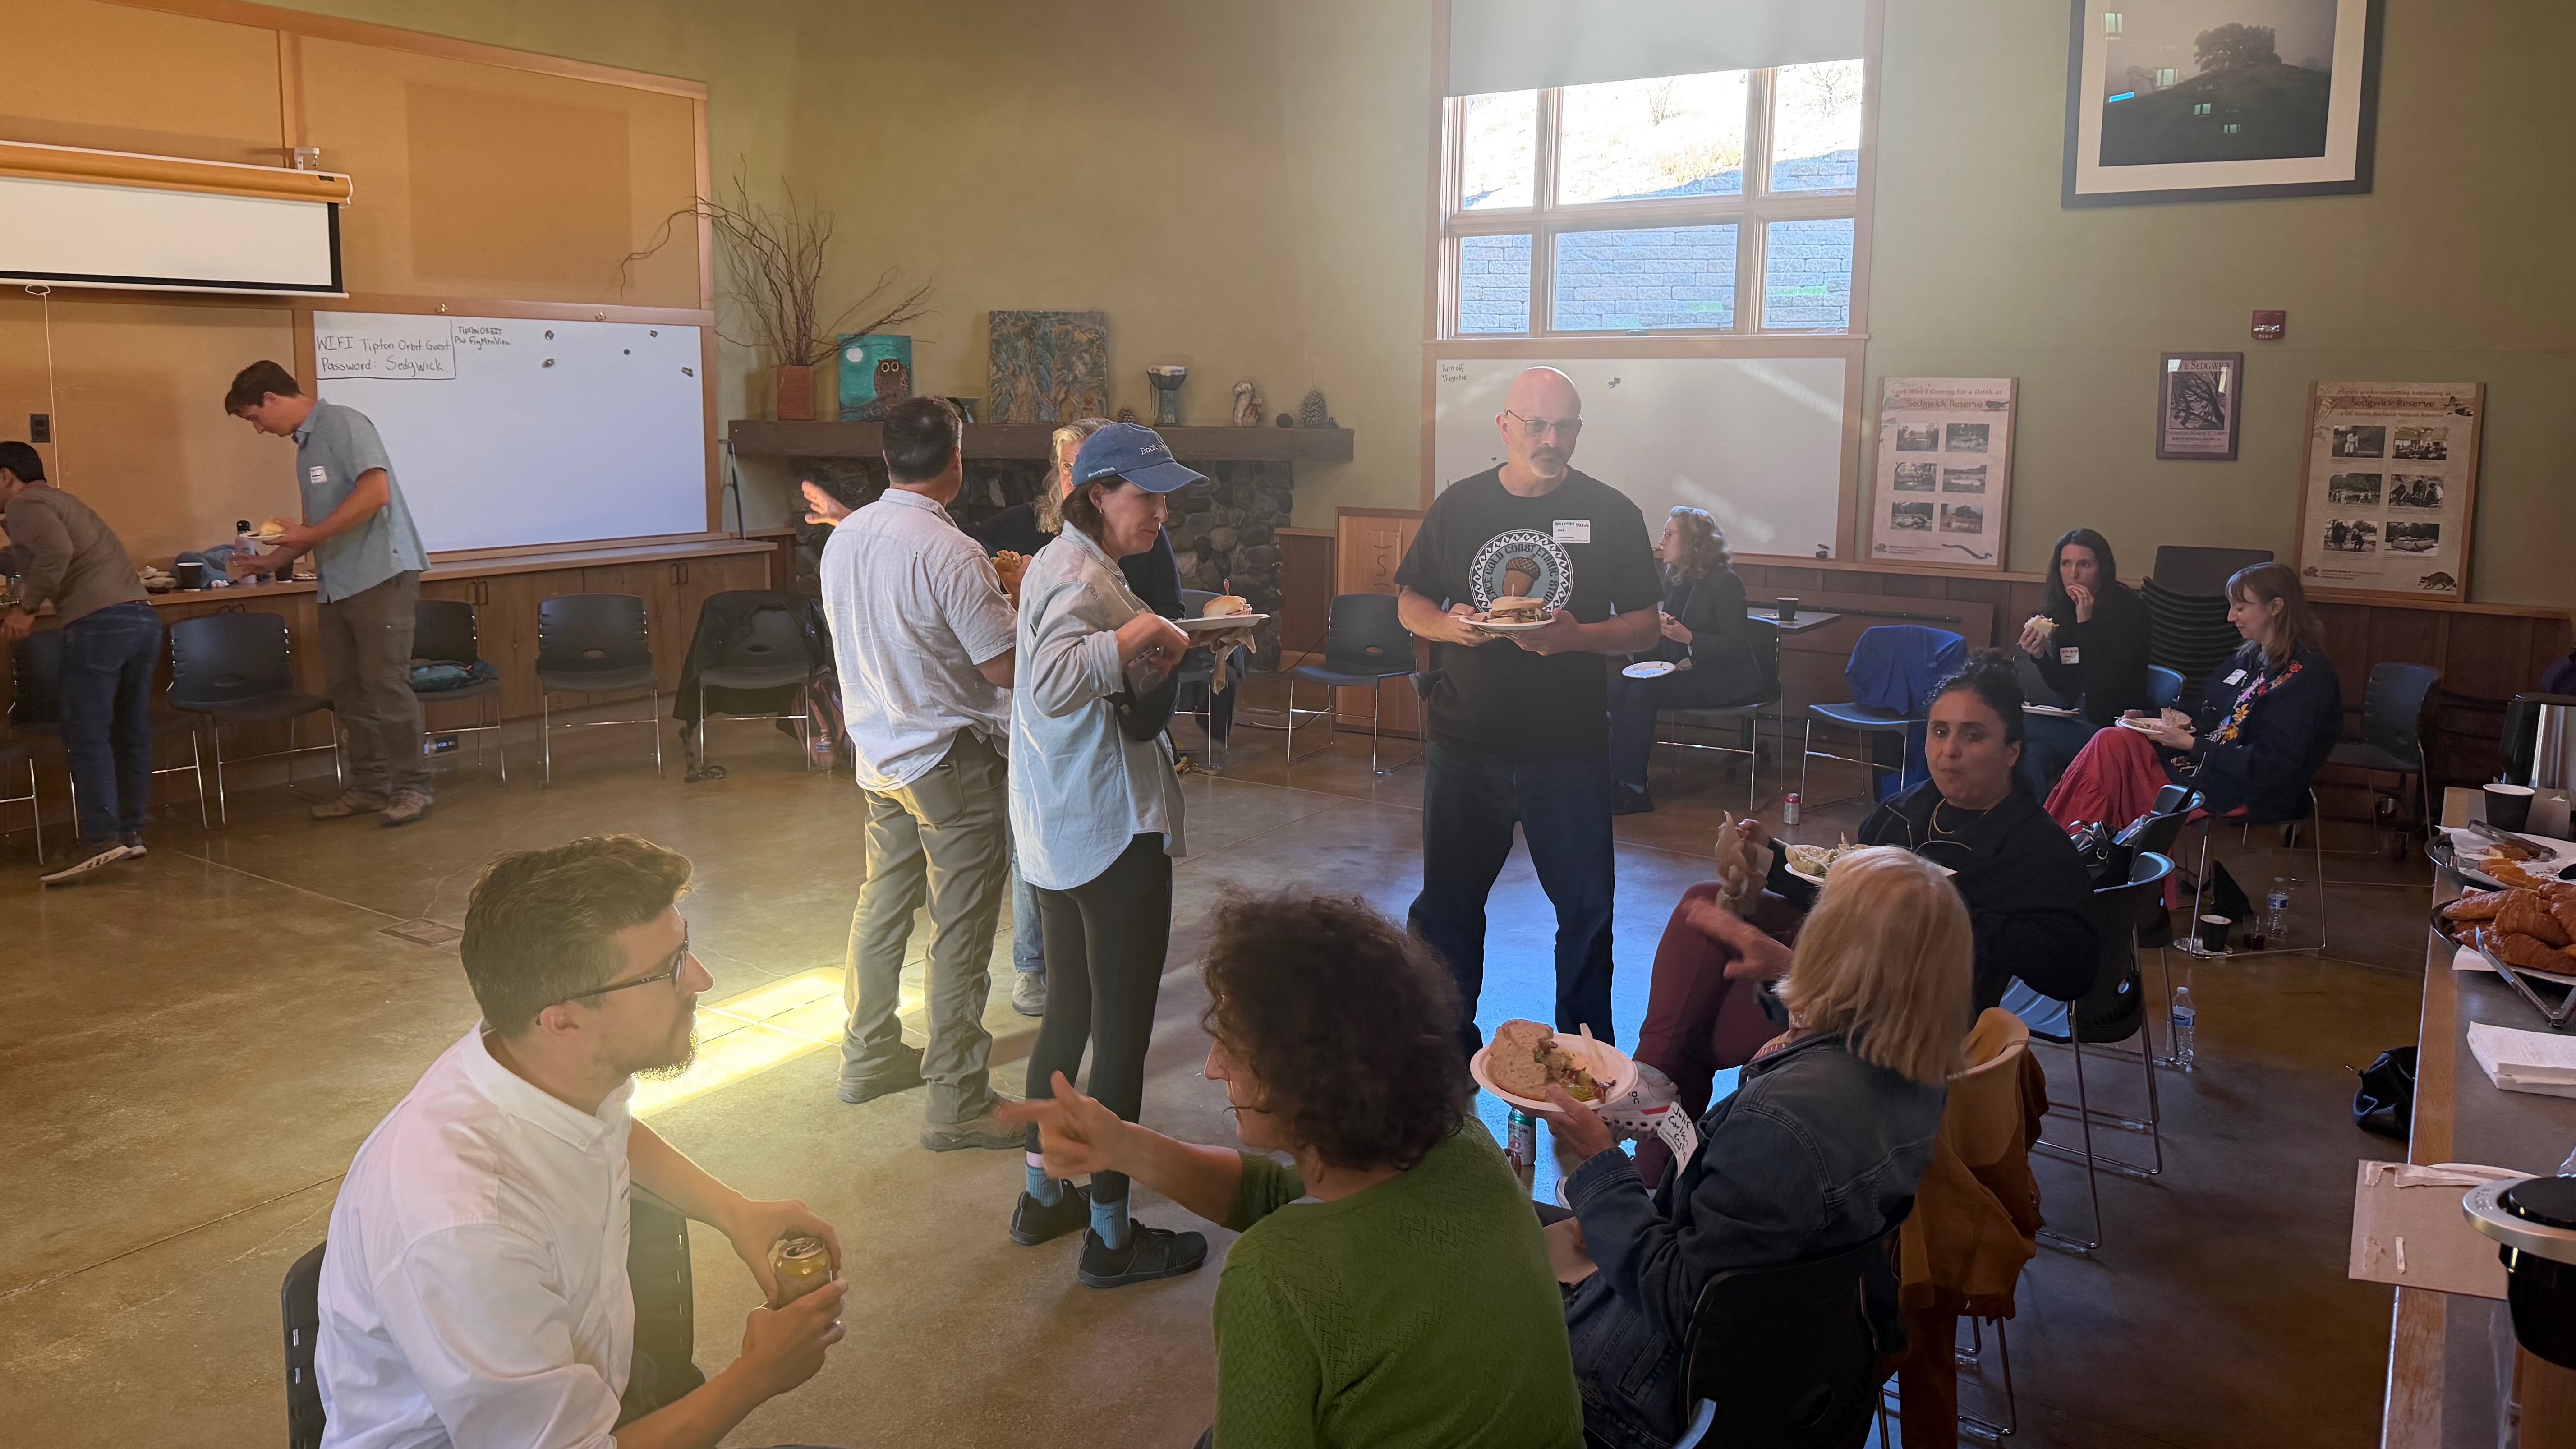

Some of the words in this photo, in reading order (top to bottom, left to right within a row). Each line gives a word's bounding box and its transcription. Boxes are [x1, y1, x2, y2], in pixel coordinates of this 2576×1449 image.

[317, 336, 354, 350] WIFI
[359, 339, 394, 354] Tipton
[398, 340, 423, 351] Orbit
[426, 340, 451, 351] Guest
[386, 355, 444, 377] Sedgwick
[1456, 363, 1465, 372] off
[1908, 400, 1946, 409] Sedgwick
[1950, 400, 1984, 408] Reserve
[2352, 398, 2394, 408] Sedgwick
[2397, 399, 2435, 408] Reserve
[1140, 443, 1158, 455] Book
[1485, 552, 1504, 575] GOLD
[1505, 543, 1537, 555] COAST
[1535, 547, 1558, 577] ETHNIC
